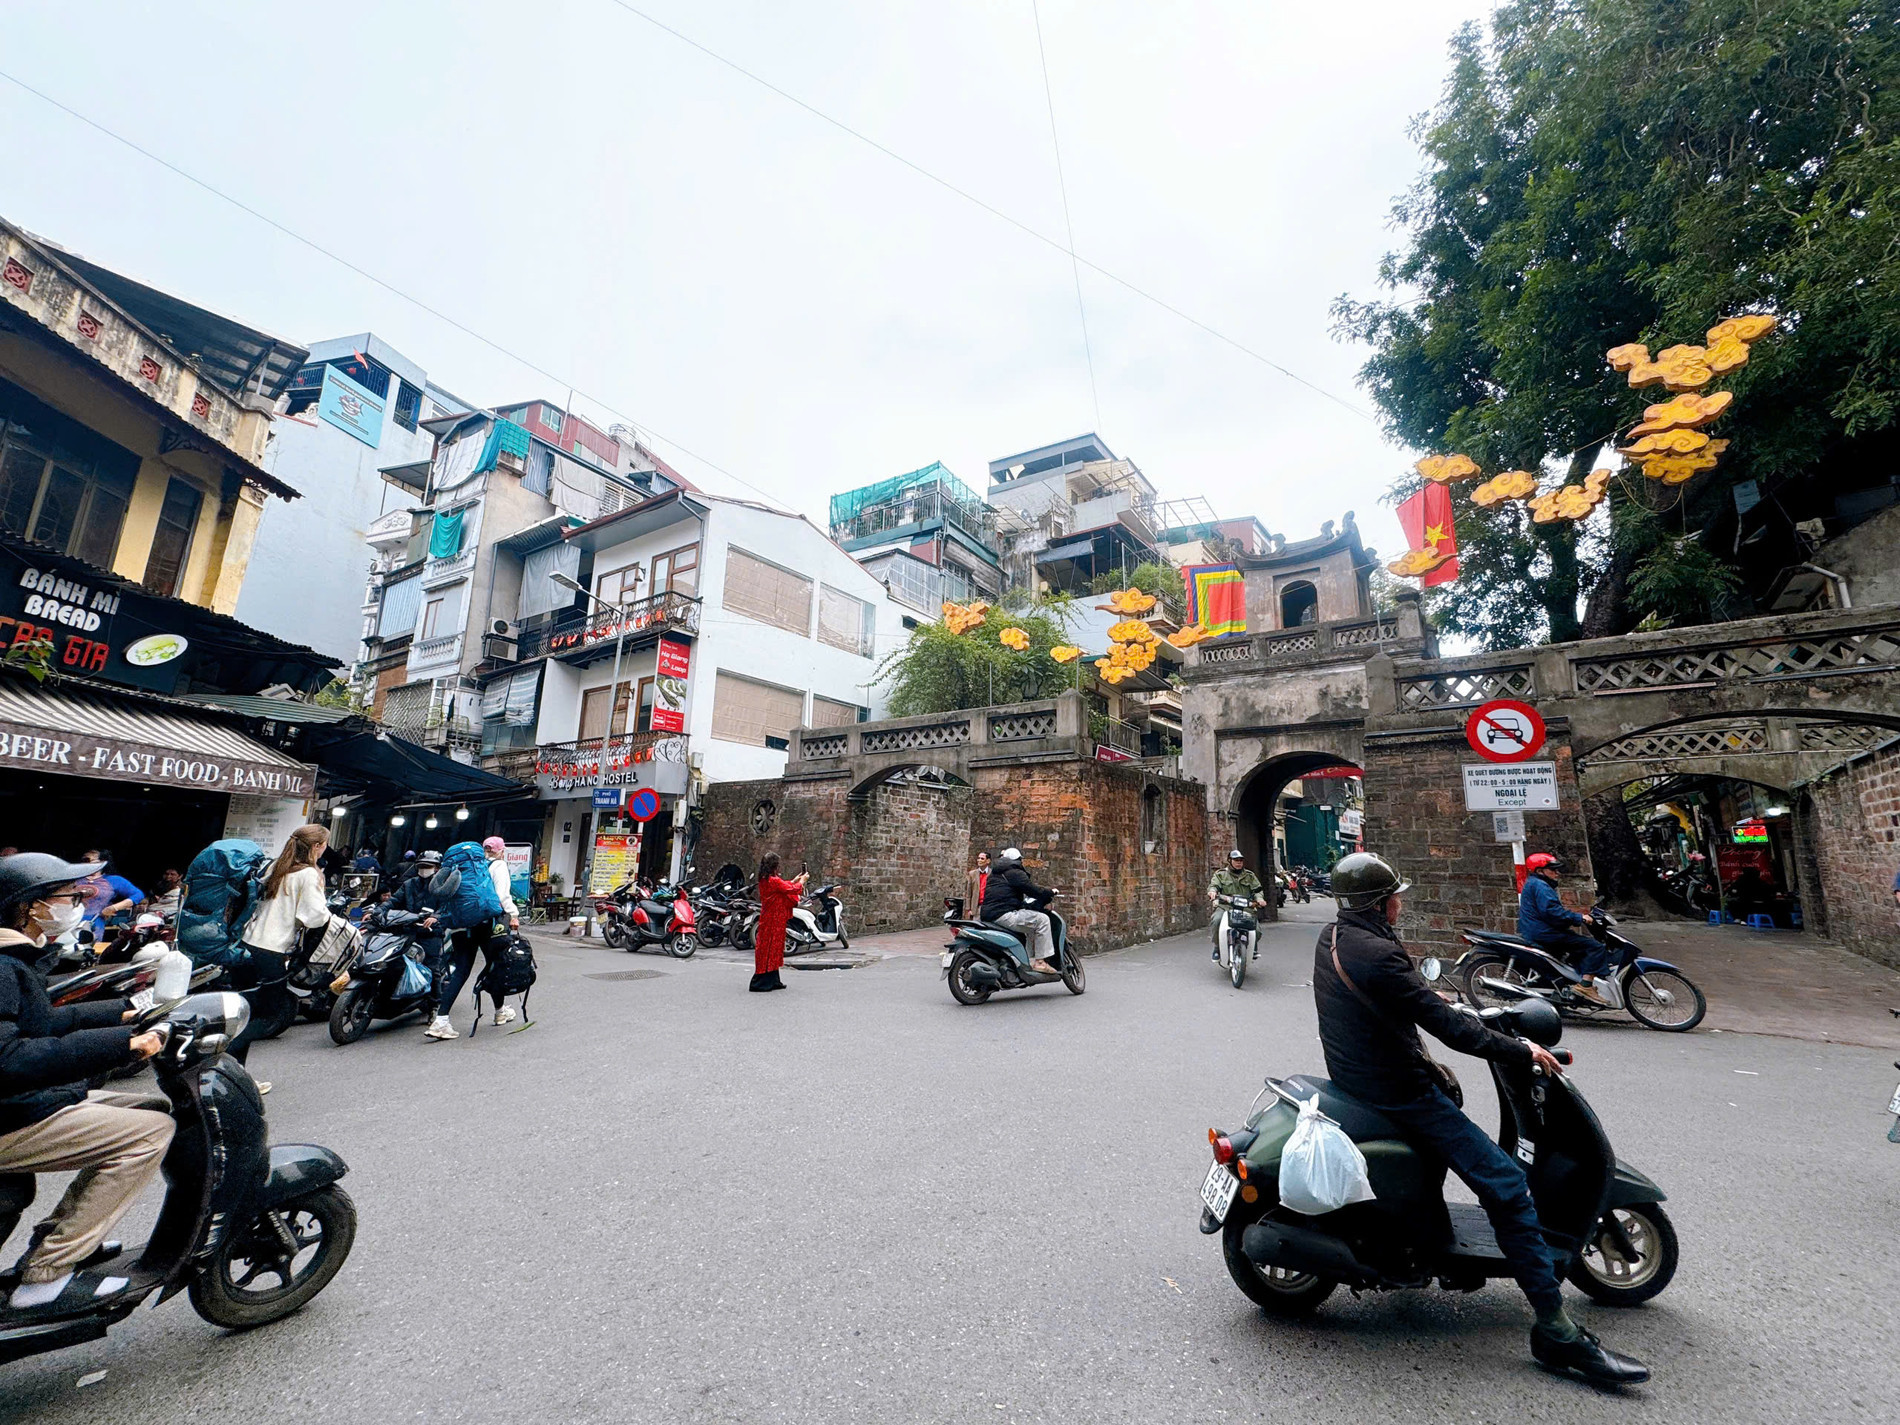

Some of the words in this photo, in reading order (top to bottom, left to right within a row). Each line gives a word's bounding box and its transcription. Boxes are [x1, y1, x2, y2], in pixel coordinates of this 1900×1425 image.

[20, 568, 88, 605] BÁNH
[90, 590, 120, 615] MÌ
[24, 594, 100, 632] BREAD
[63, 635, 109, 671] GIA
[0, 731, 71, 765] BEER
[92, 747, 155, 775] FAST
[159, 757, 220, 783] FOOD
[233, 767, 282, 791] BANH
[603, 771, 637, 786] HOSTEL
[1495, 789, 1517, 799] NGOẠI
[1518, 787, 1527, 798] LỆ
[1498, 798, 1527, 807] Except
[507, 852, 529, 862] Giang
[1202, 1179, 1228, 1217] 498.08
